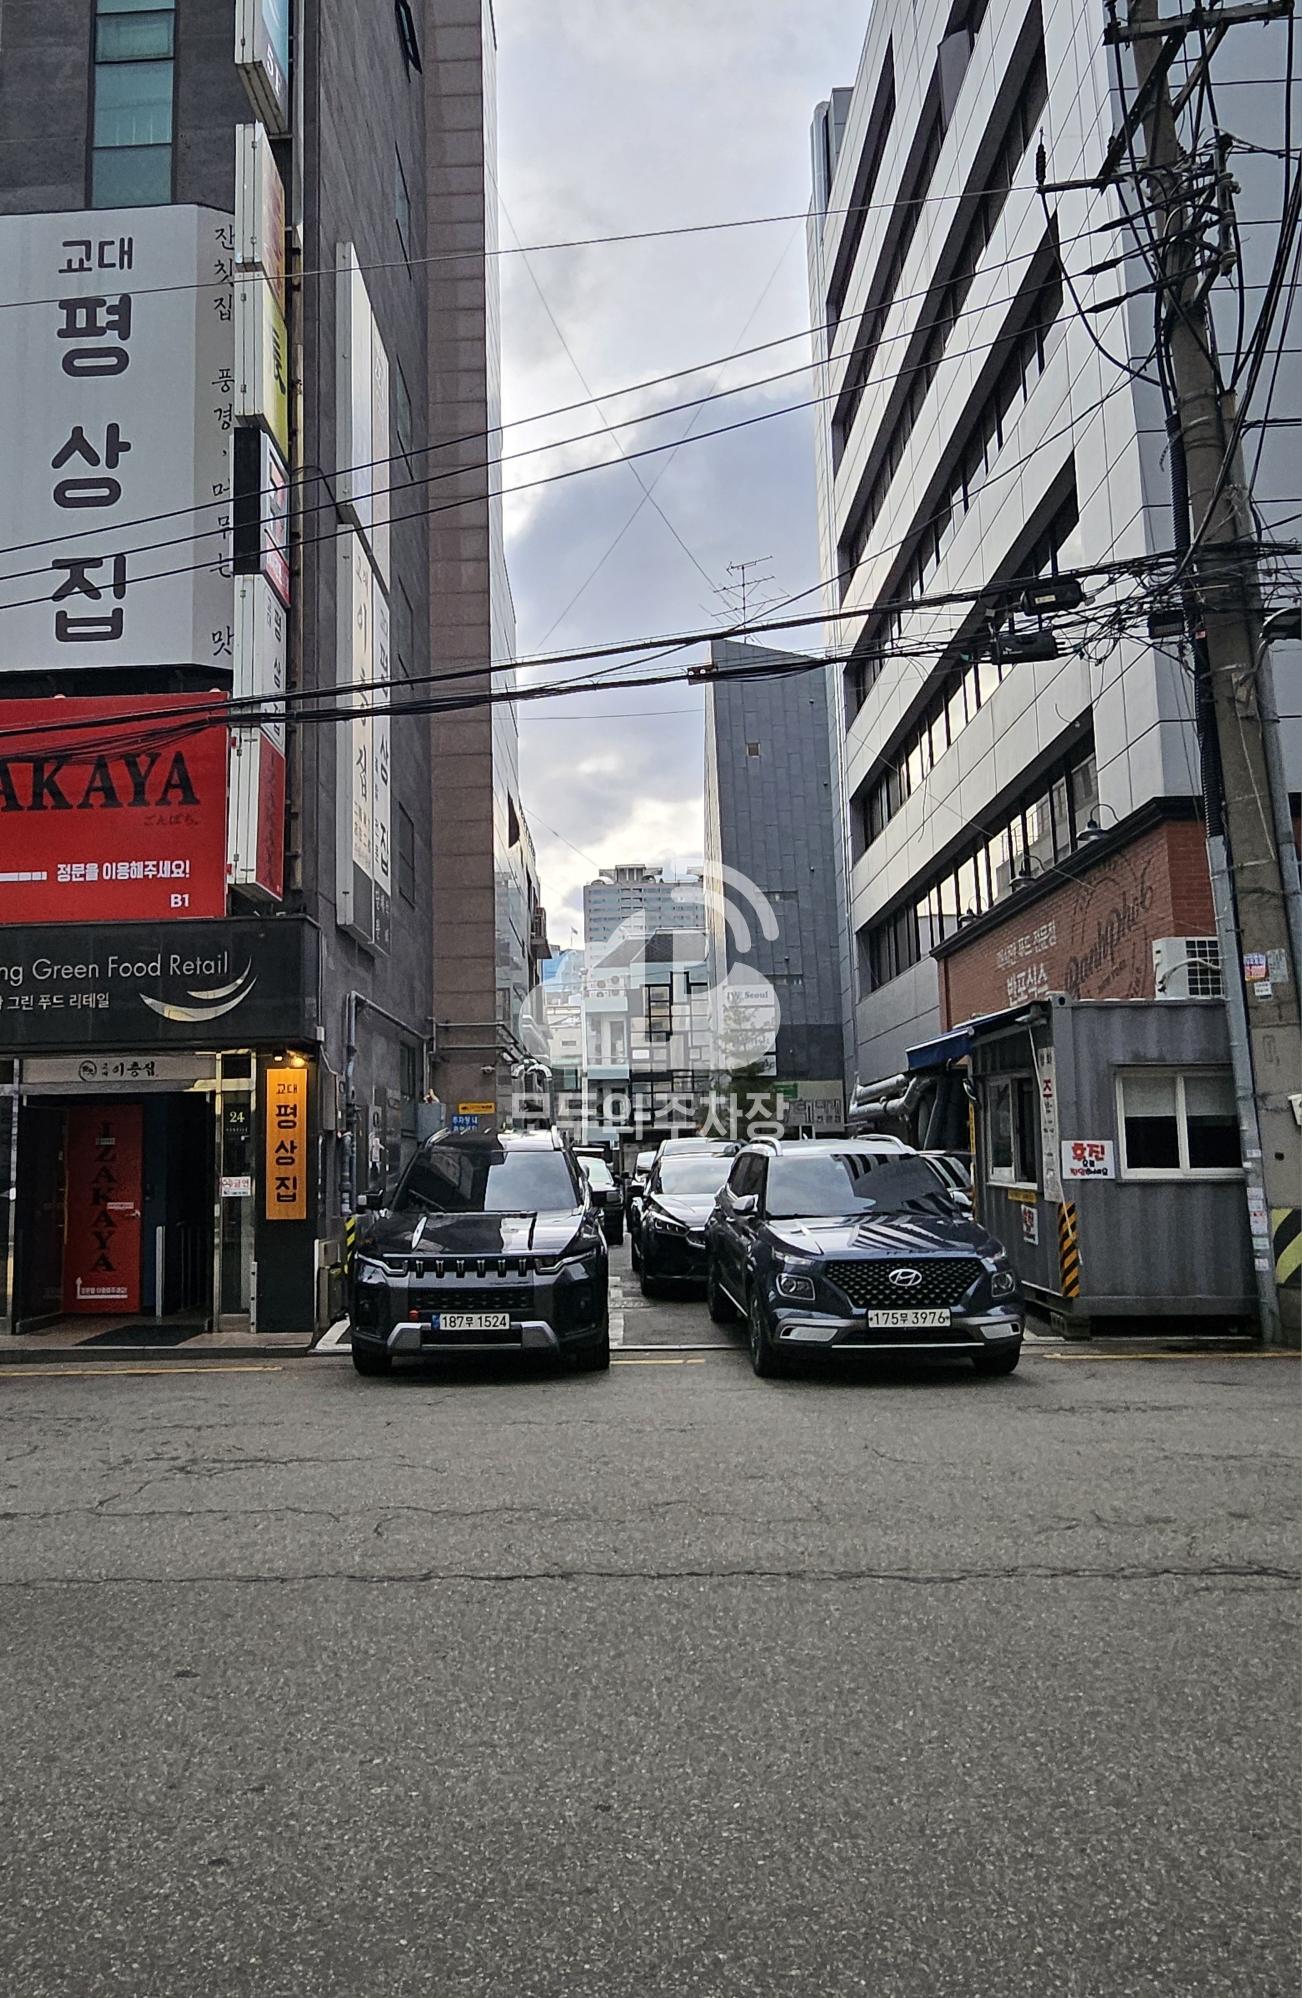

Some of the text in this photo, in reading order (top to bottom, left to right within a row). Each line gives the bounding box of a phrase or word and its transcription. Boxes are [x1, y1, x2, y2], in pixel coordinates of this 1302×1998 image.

[58, 237, 134, 274] 교대
[51, 293, 132, 643] 평상집
[211, 625, 235, 657] 맛
[57, 860, 190, 882] 정문을 이용해주세요!
[170, 893, 190, 907] B1
[32, 958, 100, 980] Green
[107, 953, 161, 978] Food
[169, 951, 228, 976] Retail
[7, 992, 110, 1010] 그린 푸드 리테일
[275, 1083, 298, 1094] 교대
[229, 1111, 245, 1123] 24
[275, 1103, 298, 1203] 평상집
[442, 1315, 507, 1328] 187무 1524
[874, 1311, 946, 1325] 175무 3976
